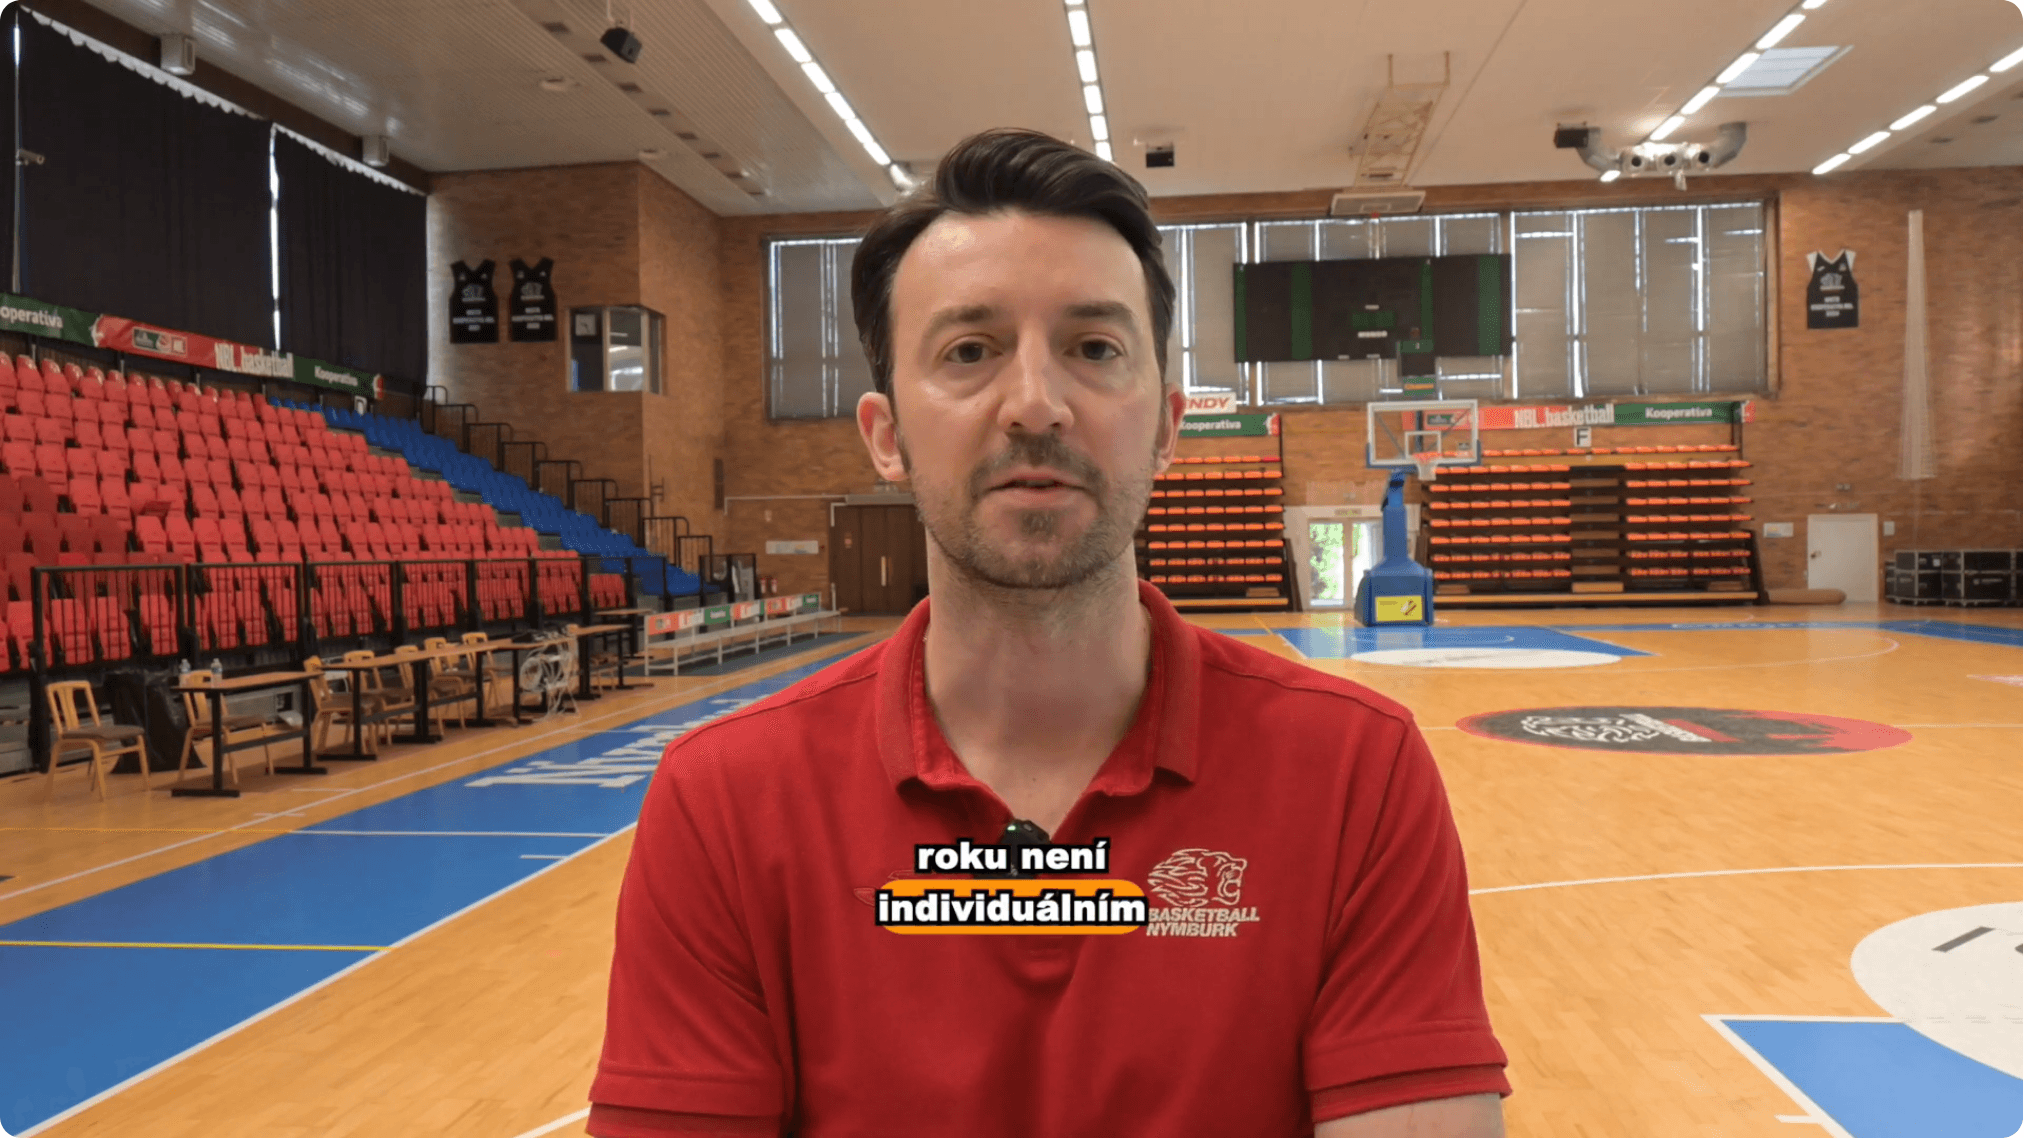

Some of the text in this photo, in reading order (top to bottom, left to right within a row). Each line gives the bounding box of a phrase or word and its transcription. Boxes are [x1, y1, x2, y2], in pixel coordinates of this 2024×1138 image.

[1184, 397, 1231, 410] NDY
[1644, 406, 1713, 421] Kooperativa
[1576, 427, 1591, 446] F
[1148, 906, 1261, 922] BASKETBALL
[1146, 922, 1240, 937] NYMBURK
